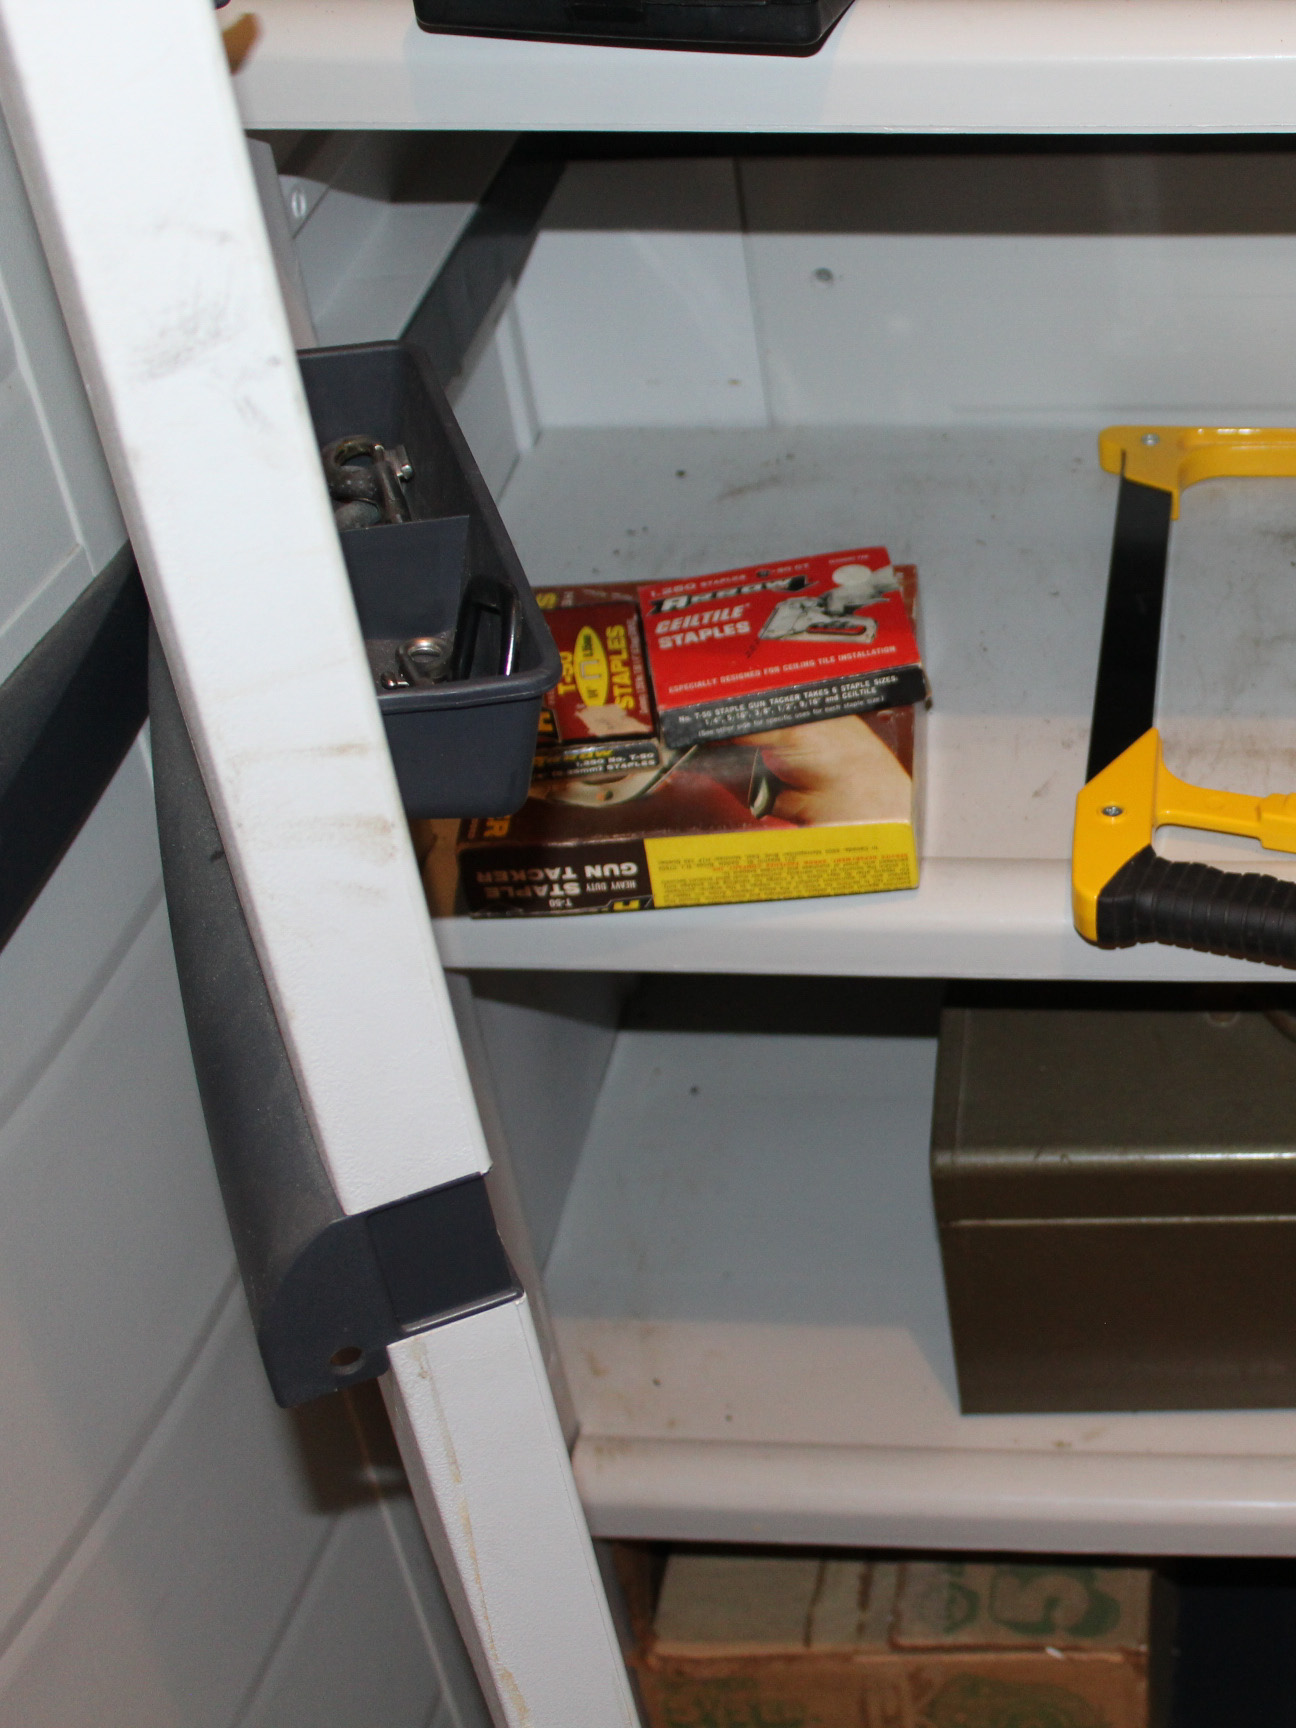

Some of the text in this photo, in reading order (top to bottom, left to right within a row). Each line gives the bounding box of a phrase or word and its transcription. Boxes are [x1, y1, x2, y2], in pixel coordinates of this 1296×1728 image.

[655, 605, 744, 634] CEILTILE
[658, 621, 750, 650] STAPLES
[606, 625, 635, 710] STAPLES
[668, 646, 896, 693] ESPECIALLY DESIGNED FOR CEILING TILE INSTALLATION
[715, 704, 745, 716] STAPLE
[748, 700, 766, 710] GUN
[769, 692, 800, 706] TACKER
[803, 687, 830, 699] TAKES
[841, 680, 870, 693] STAPLE
[824, 694, 839, 704] and
[842, 686, 876, 700] CEILTILE
[606, 760, 656, 771] STAPLES
[476, 862, 639, 884] GUN TACKER
[484, 881, 581, 899] STAPLE
[586, 880, 637, 893] HEAVY DUTY
